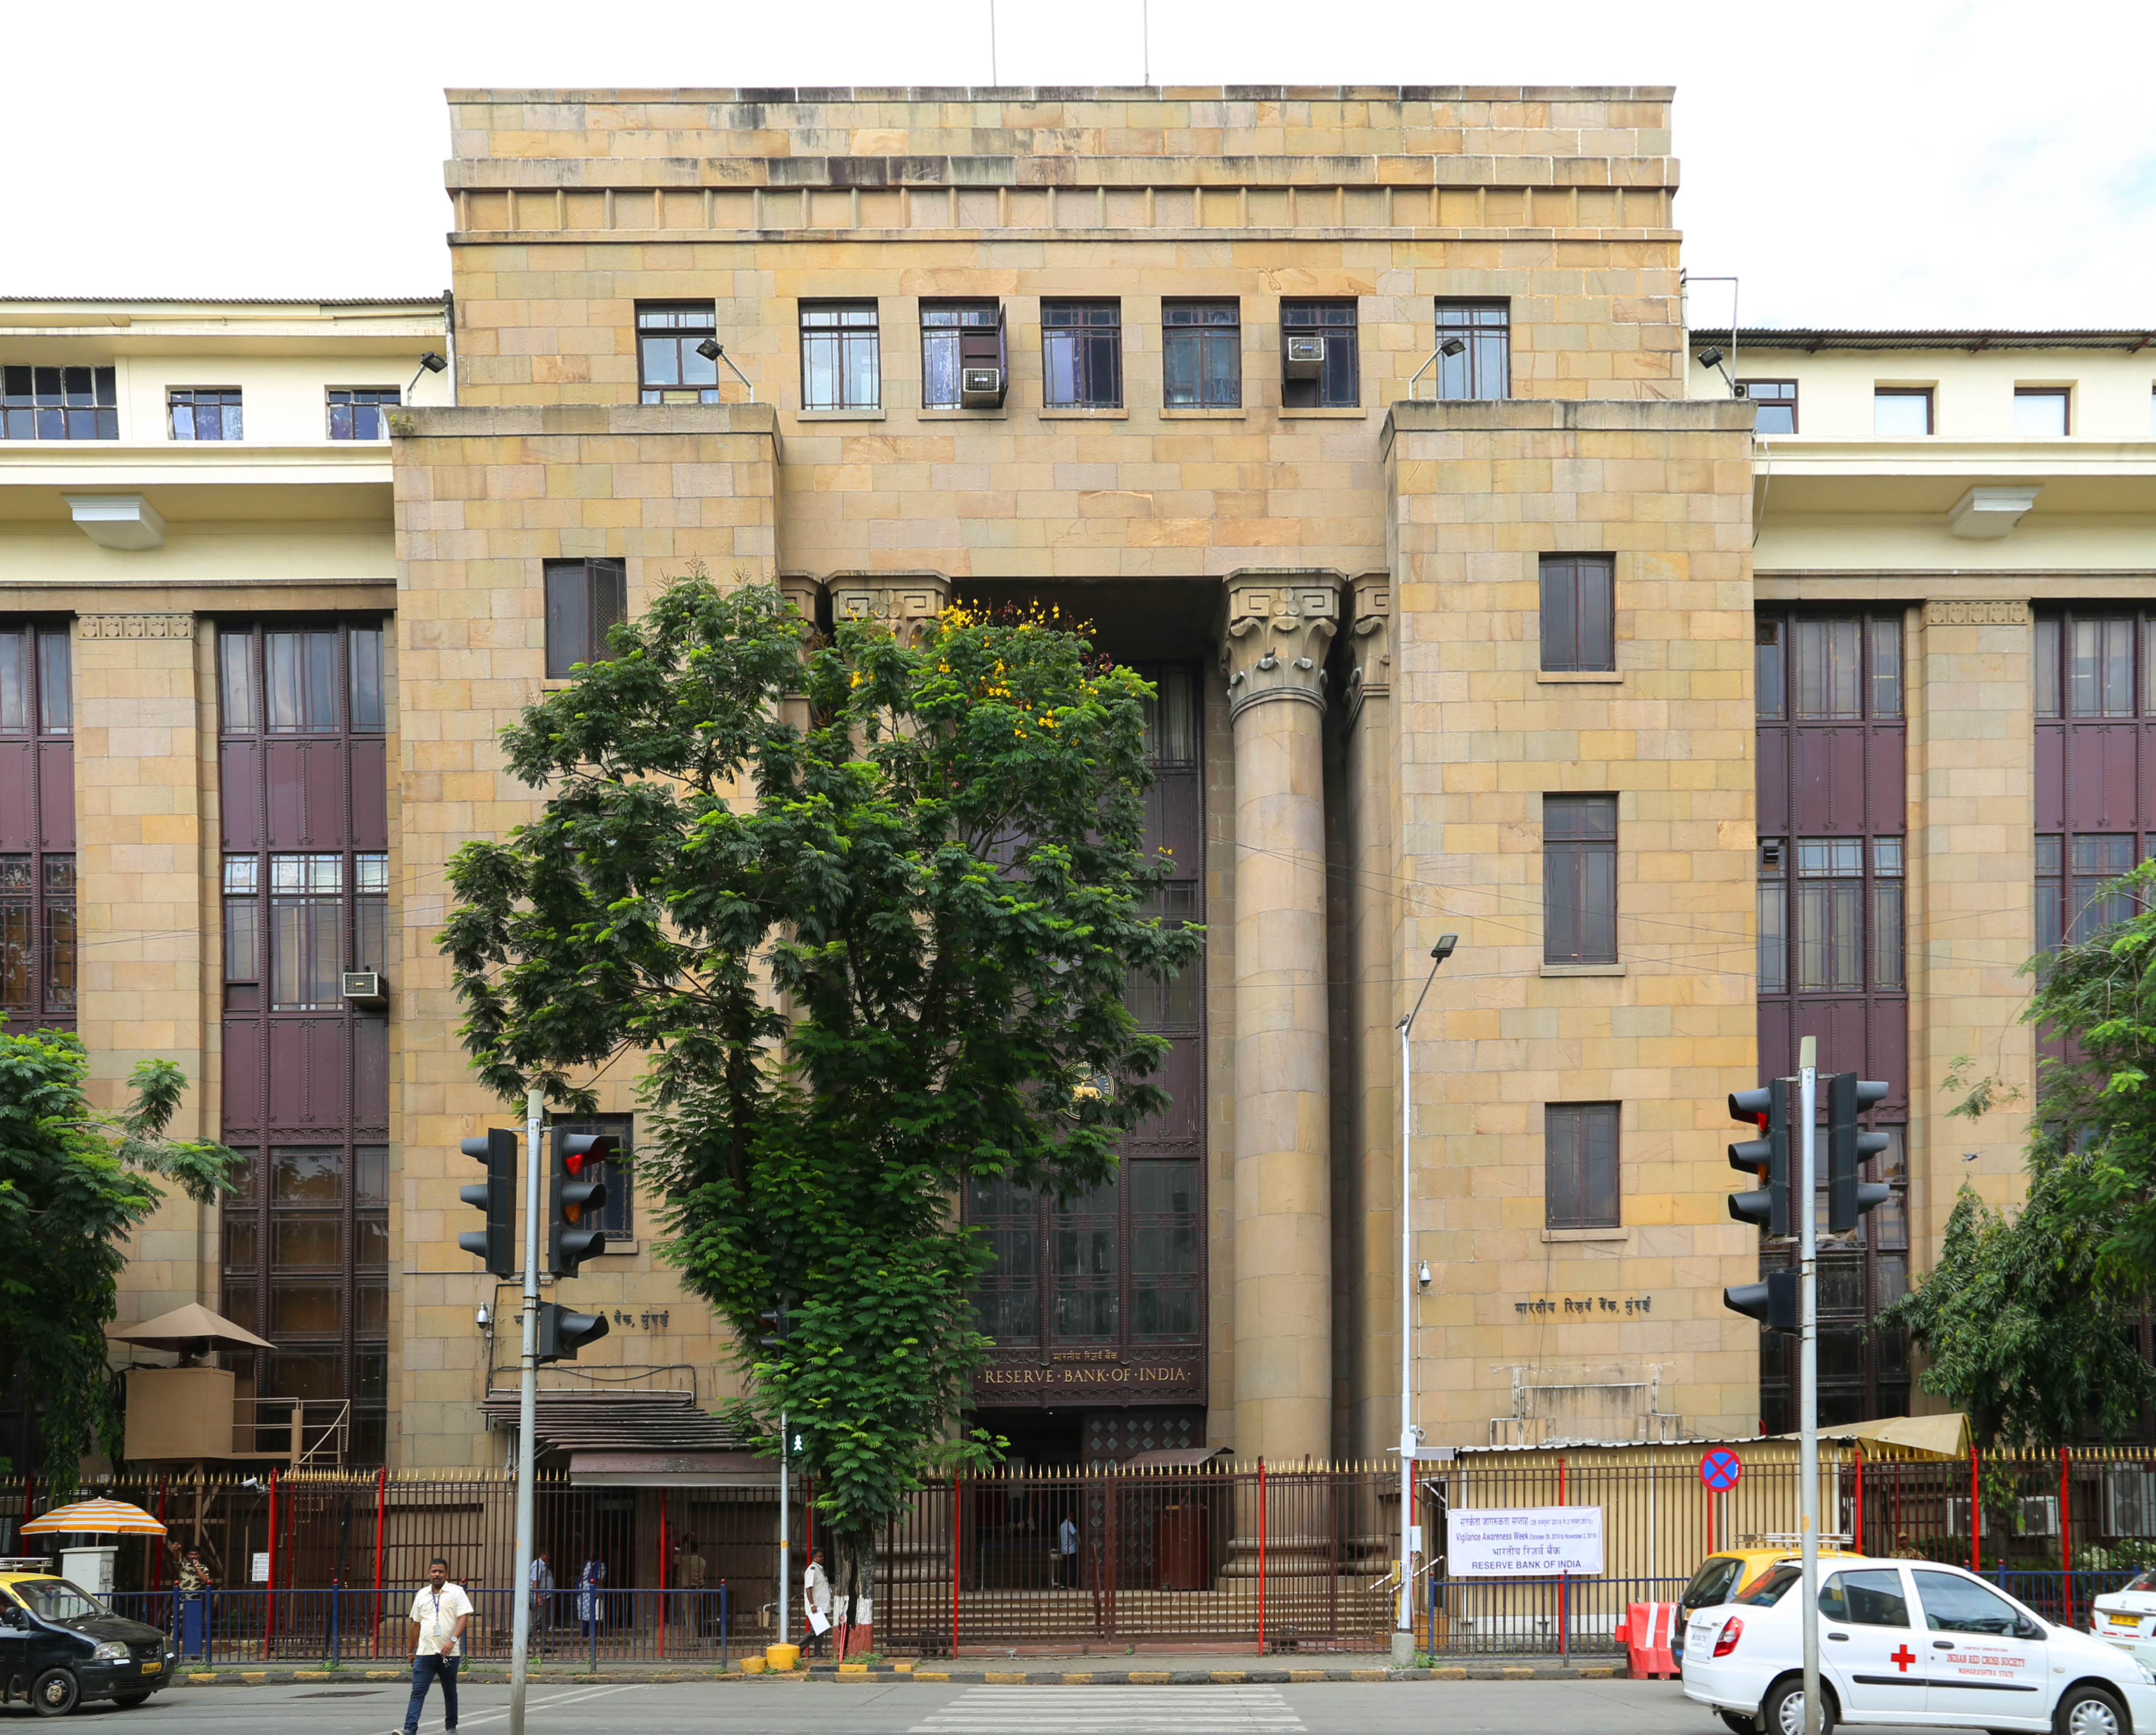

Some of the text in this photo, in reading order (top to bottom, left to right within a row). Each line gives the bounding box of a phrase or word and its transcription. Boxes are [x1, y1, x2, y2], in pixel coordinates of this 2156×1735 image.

[1515, 1299, 1556, 1314] भारतीय
[1052, 1351, 1081, 1361] भारतीय
[1105, 1349, 1118, 1359] बैंक
[985, 1368, 1185, 1383] RESERVE BANK OF INDIA
[1460, 1515, 1480, 1526] सतर्कता
[1511, 1517, 1528, 1526] सप्ताह
[1456, 1532, 1481, 1543] Vigilance
[1482, 1532, 1512, 1541] Awareness
[1513, 1531, 1528, 1540] Week
[1493, 1546, 1520, 1556] भारतीय
[1547, 1544, 1560, 1556] बैंक
[1558, 1560, 1581, 1568] INDIA
[1947, 1654, 2025, 1667] INDIAN RED CROSS SOCIETY
[1958, 1668, 1996, 1676] MAHARASHTRA
